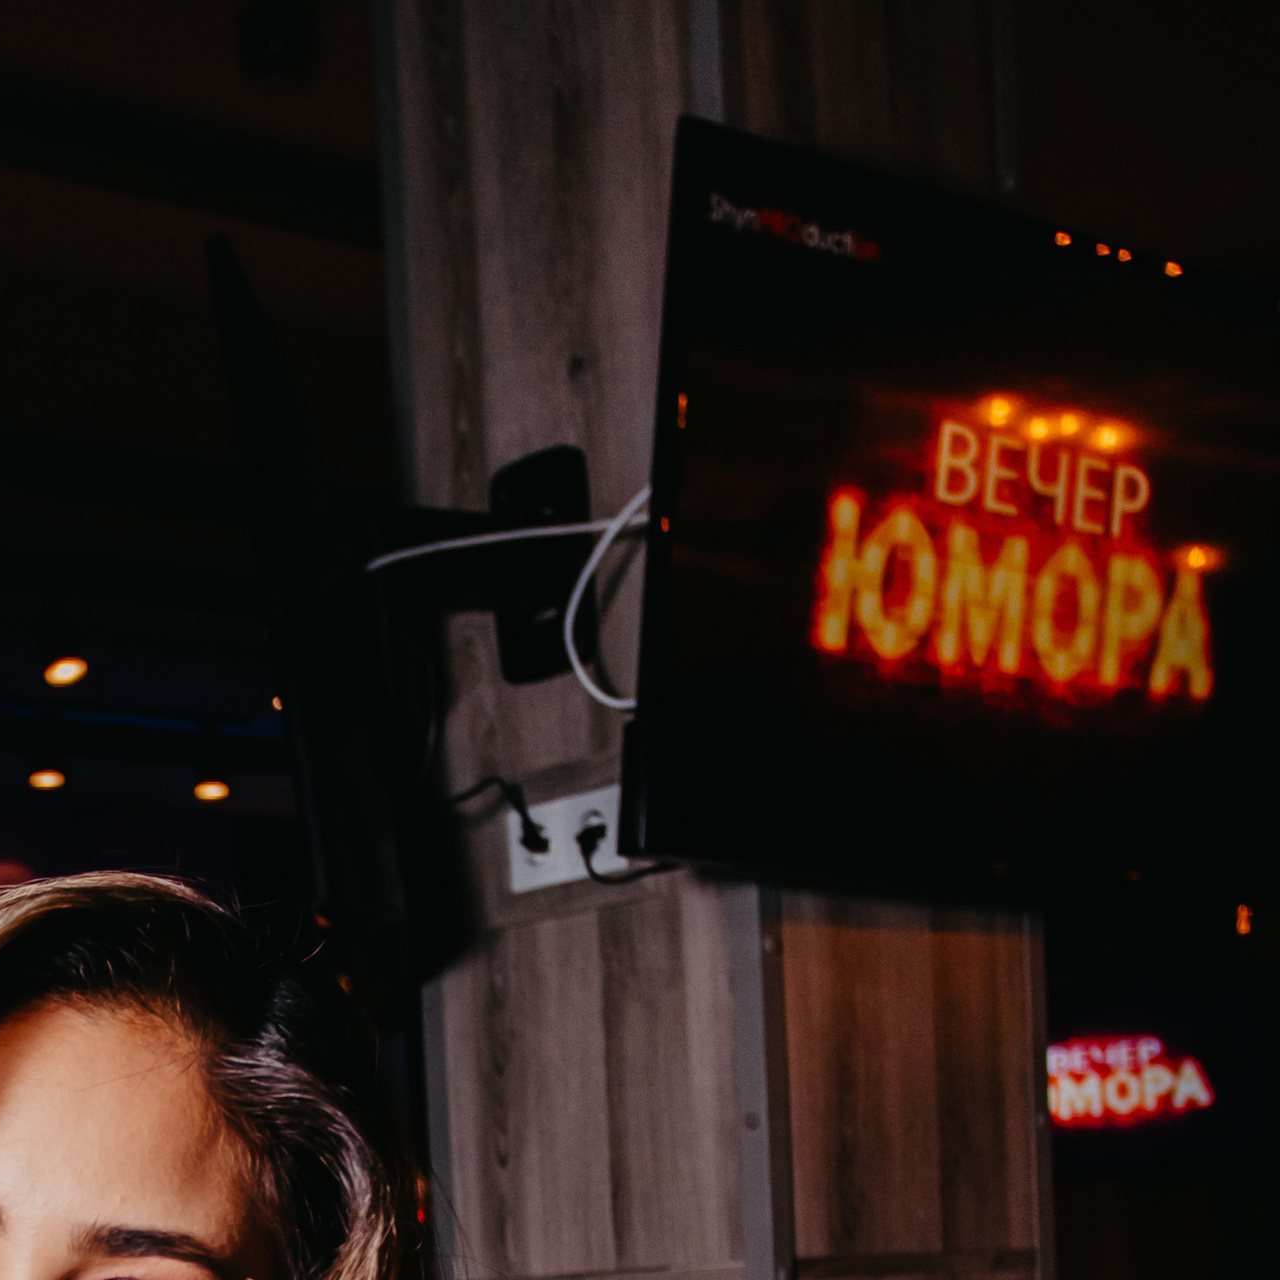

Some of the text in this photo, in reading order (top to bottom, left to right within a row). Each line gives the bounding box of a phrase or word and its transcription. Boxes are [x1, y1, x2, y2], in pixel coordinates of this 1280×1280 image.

[934, 421, 1152, 540] ВЕЧЕР
[816, 490, 1216, 702] ЮМОРА
[1047, 1056, 1217, 1123] МОРА
